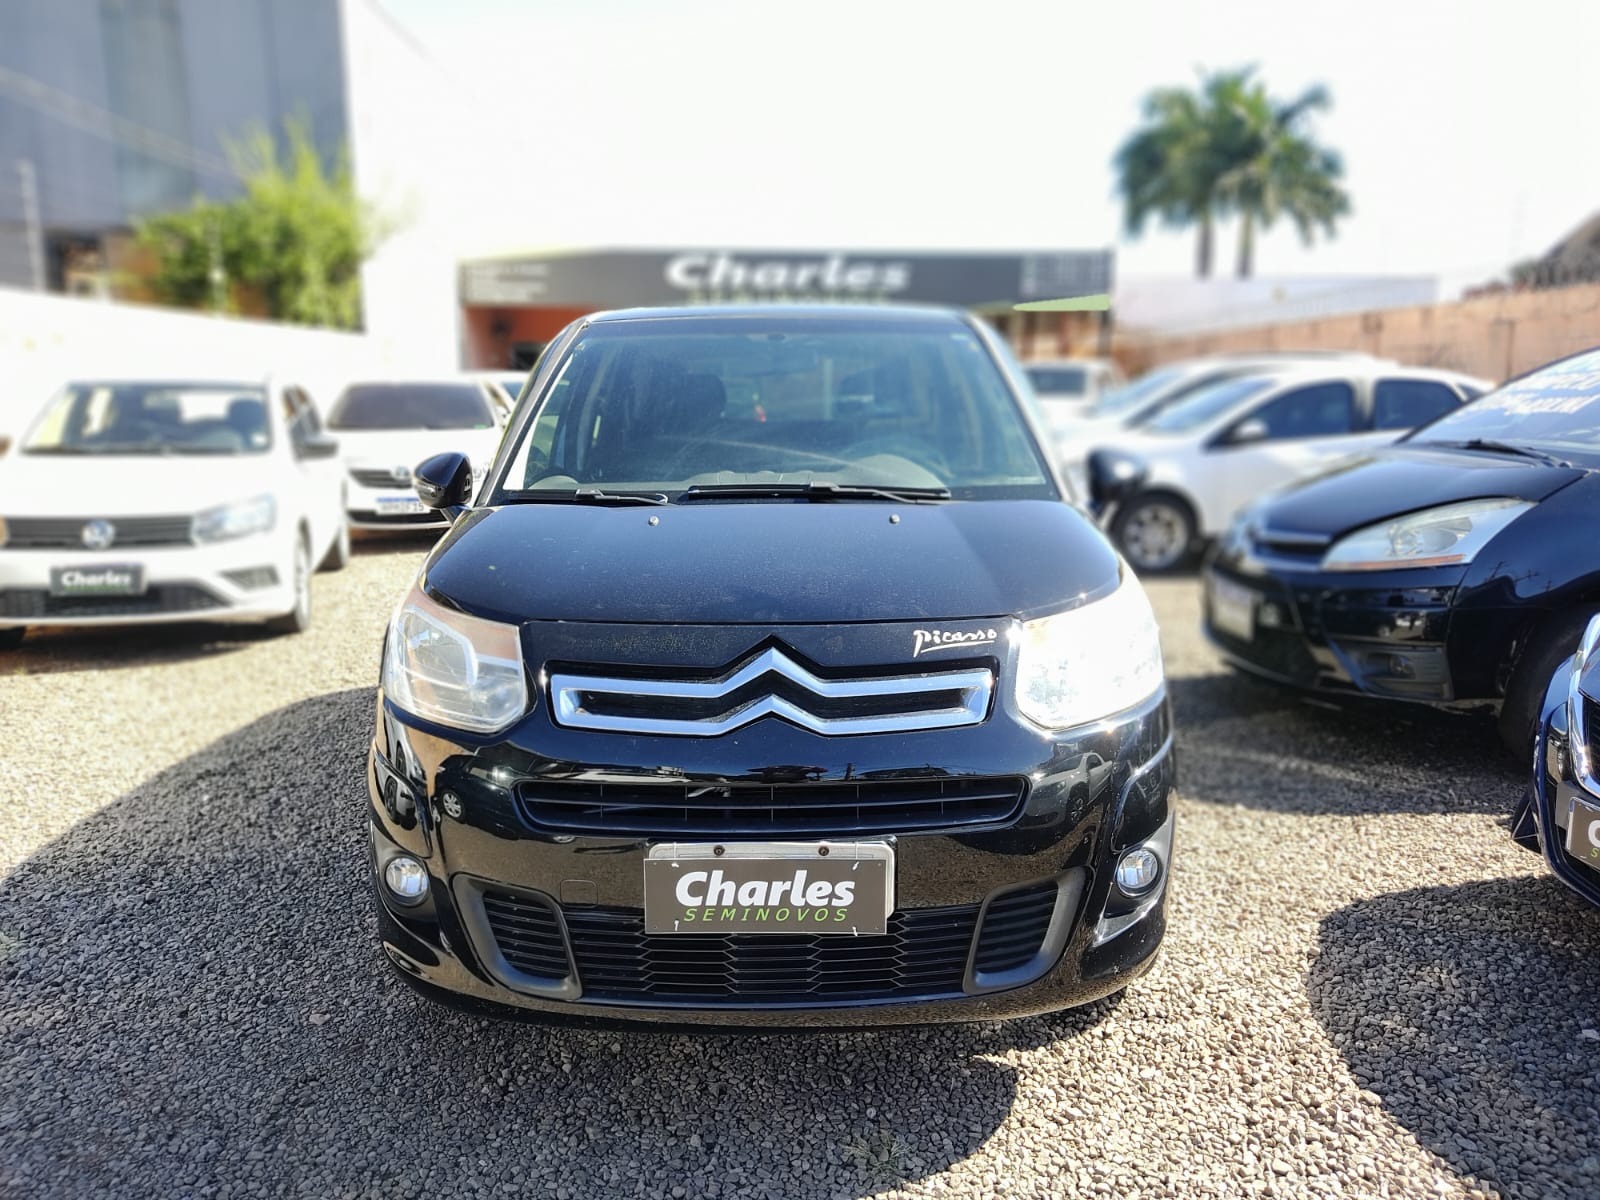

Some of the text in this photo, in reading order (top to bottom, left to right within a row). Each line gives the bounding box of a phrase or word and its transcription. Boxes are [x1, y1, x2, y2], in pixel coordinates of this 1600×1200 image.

[664, 252, 910, 293] Charles
[61, 570, 130, 586] Charles
[675, 869, 856, 907] Charles
[683, 908, 847, 922] SEMINOVOS
